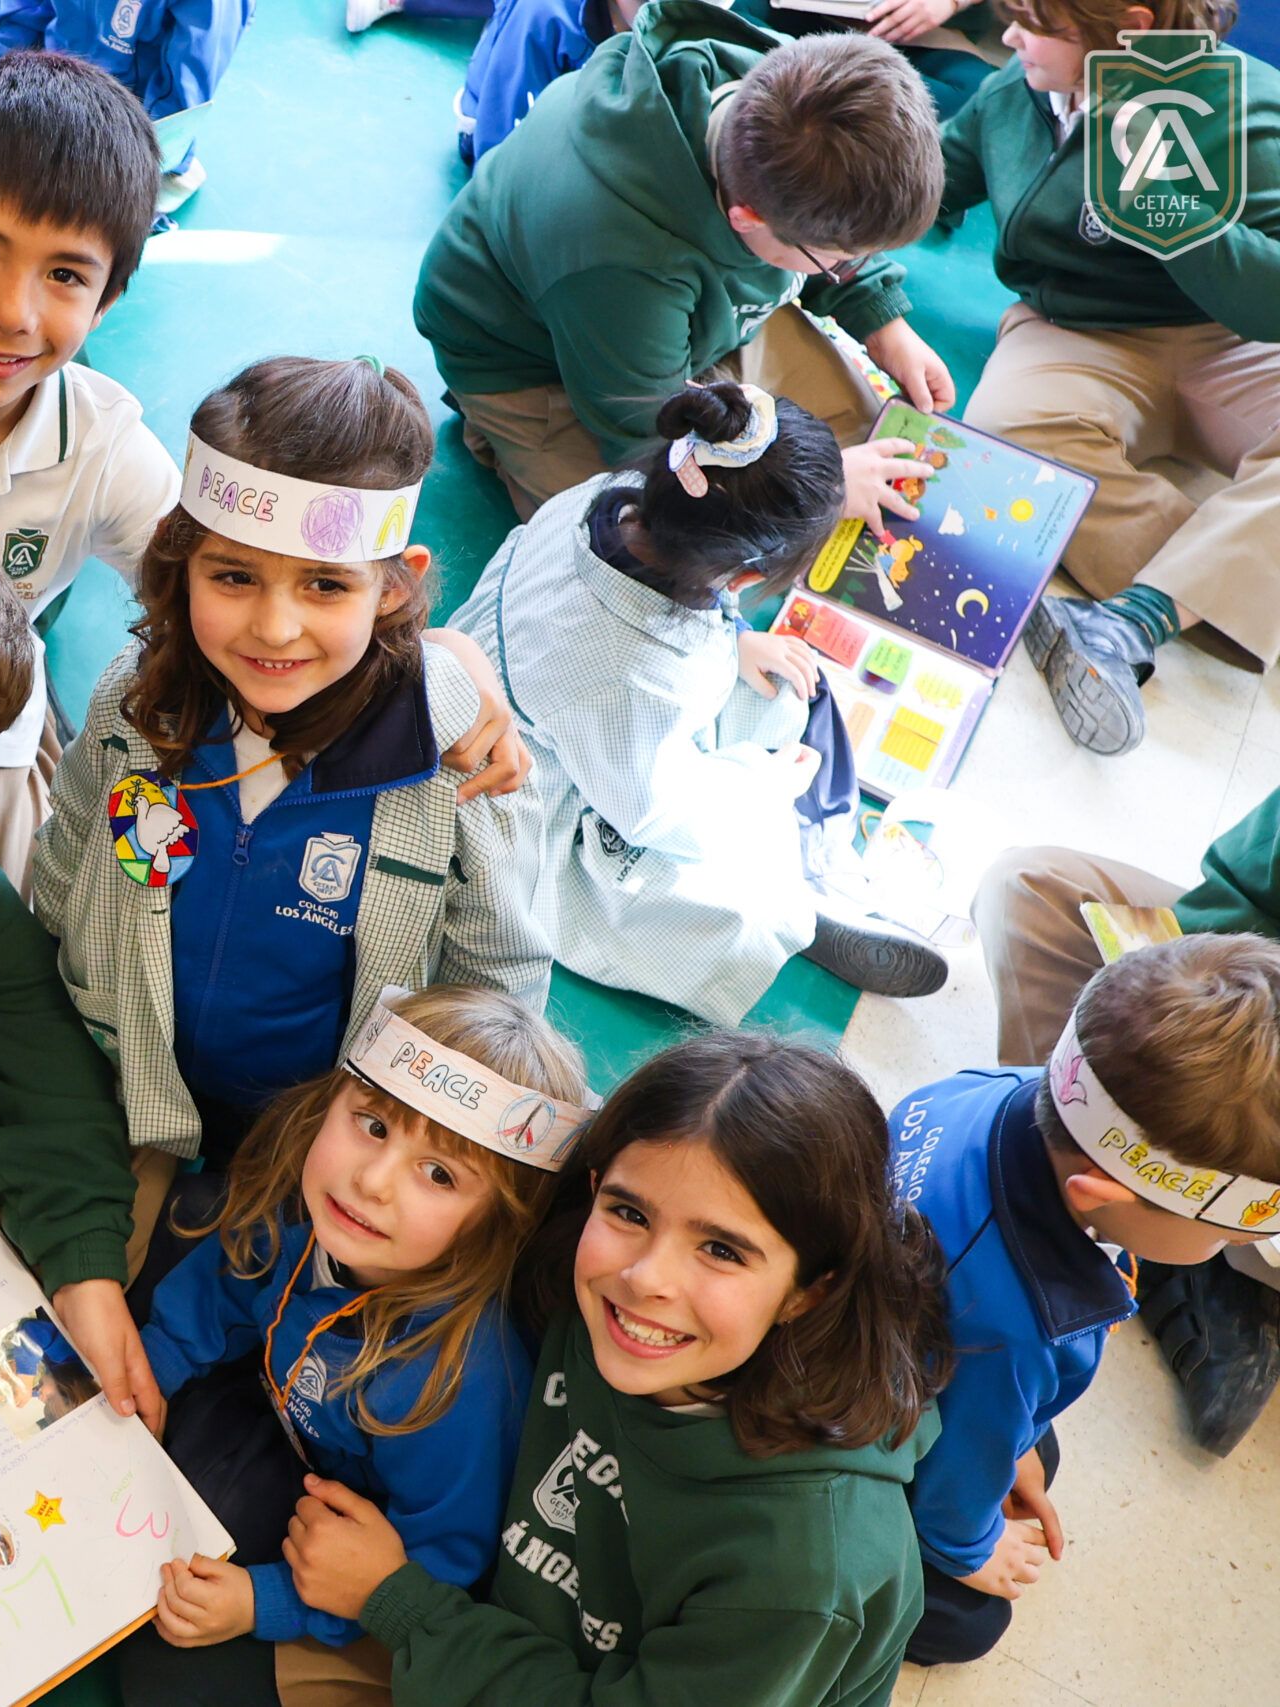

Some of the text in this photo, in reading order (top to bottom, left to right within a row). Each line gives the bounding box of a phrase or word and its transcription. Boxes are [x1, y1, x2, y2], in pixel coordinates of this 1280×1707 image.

[199, 465, 279, 522] PEACE
[275, 905, 355, 936] LOS ÁNGELES
[298, 900, 339, 920] COLEGIO
[391, 1041, 488, 1110] PEACE
[900, 1097, 934, 1141] LOS
[907, 1126, 944, 1202] COLEGIO
[1099, 1127, 1213, 1201] PEACE
[501, 1519, 622, 1652] ÁNGEES
